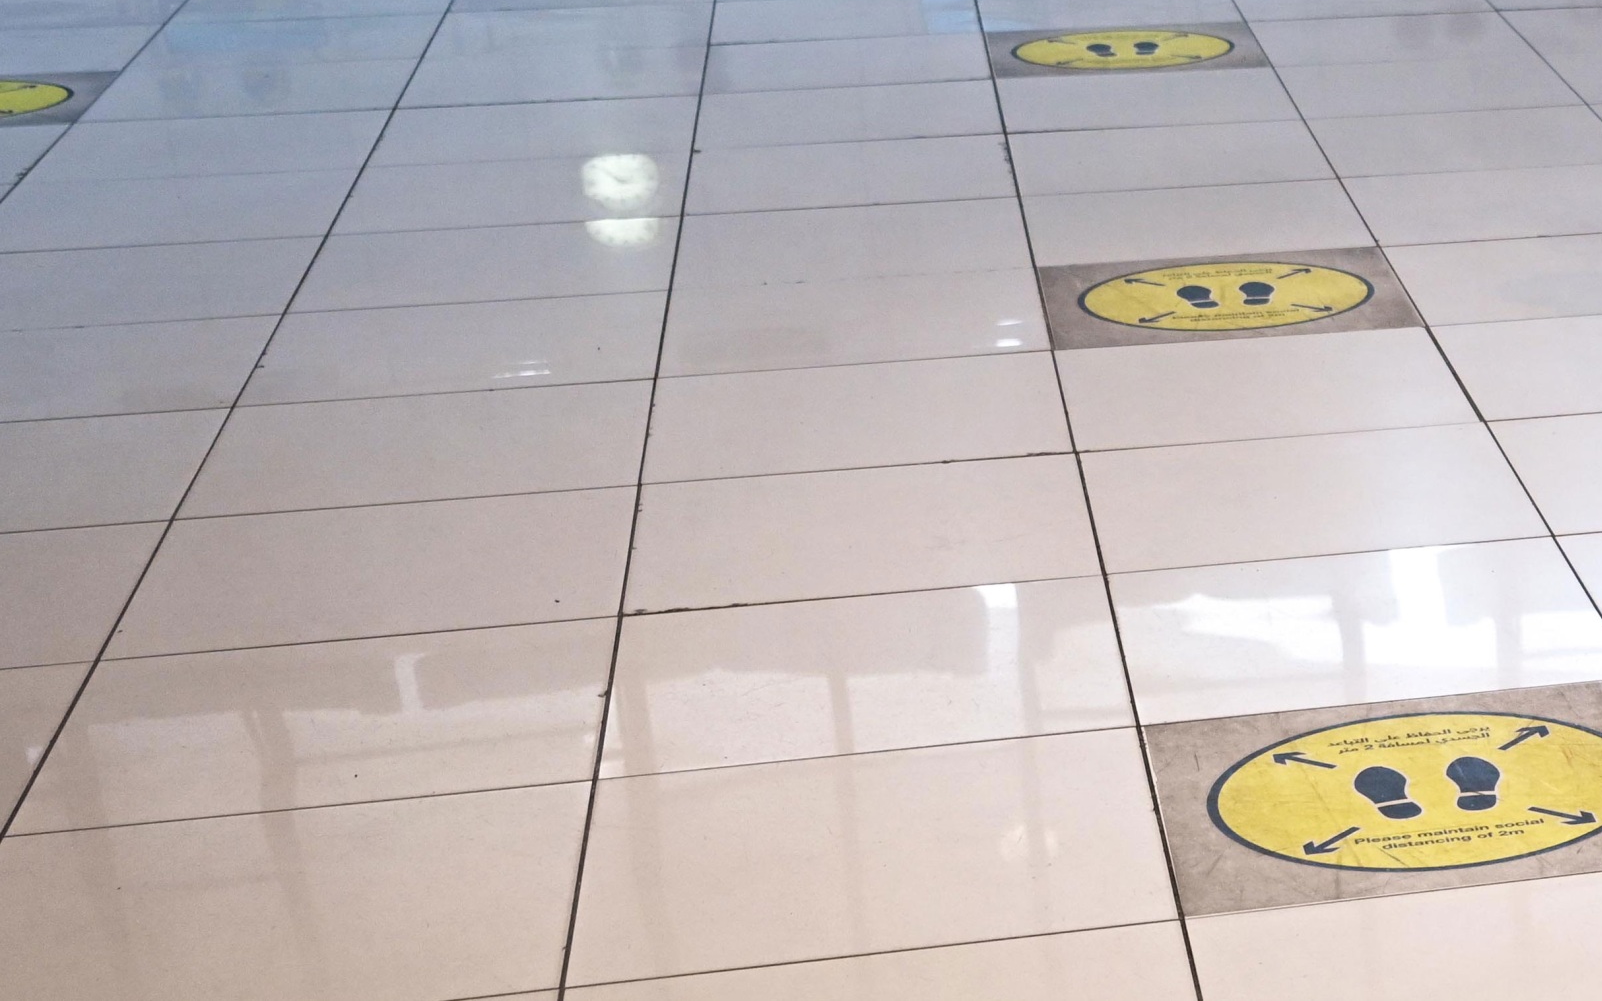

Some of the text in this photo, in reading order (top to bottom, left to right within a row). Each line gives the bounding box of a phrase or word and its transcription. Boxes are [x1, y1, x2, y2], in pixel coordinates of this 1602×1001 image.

[1406, 728, 1452, 739] الحفاظ
[1456, 726, 1491, 734] يرجى
[1374, 735, 1400, 743] على
[1378, 739, 1431, 748] لمسافة
[1435, 732, 1490, 744] الجسدي
[1354, 818, 1545, 845] Please maintain social
[1382, 828, 1524, 850] distancing of 2m
